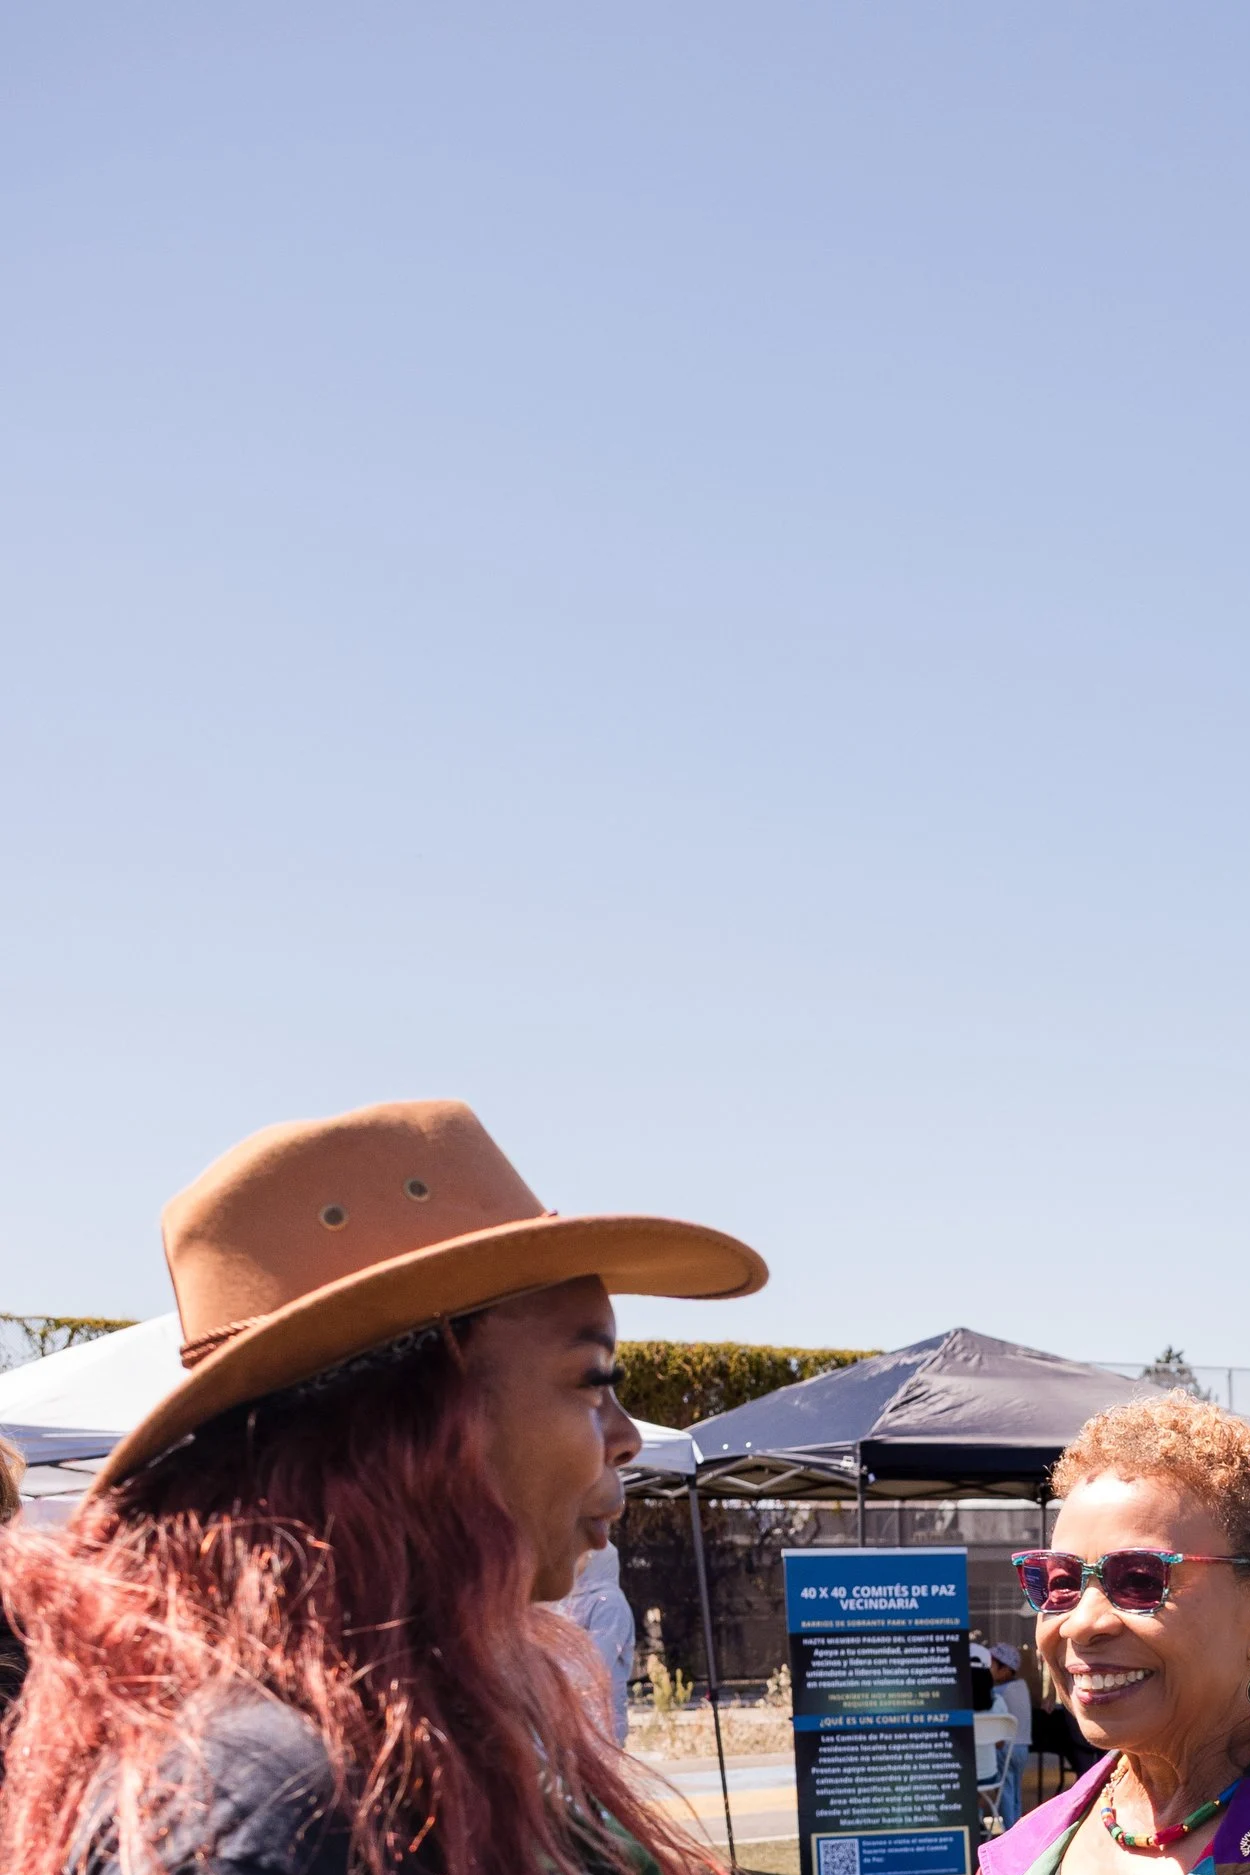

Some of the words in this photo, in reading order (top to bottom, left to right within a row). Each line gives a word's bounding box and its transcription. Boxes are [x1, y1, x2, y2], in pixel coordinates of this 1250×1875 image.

[801, 1587, 817, 1599] 40
[819, 1587, 829, 1599] X
[830, 1586, 847, 1598] 40
[852, 1582, 909, 1598] COMITÉS
[911, 1585, 928, 1597] DE
[931, 1584, 956, 1597] PAZ
[840, 1598, 919, 1610] VECINDARIA
[819, 1716, 843, 1728] ¿QUÉ
[845, 1716, 857, 1725] ES
[858, 1716, 874, 1725] UN
[875, 1713, 911, 1724] COMITÉ
[912, 1714, 924, 1723] DE
[926, 1713, 949, 1723] PAZ?
